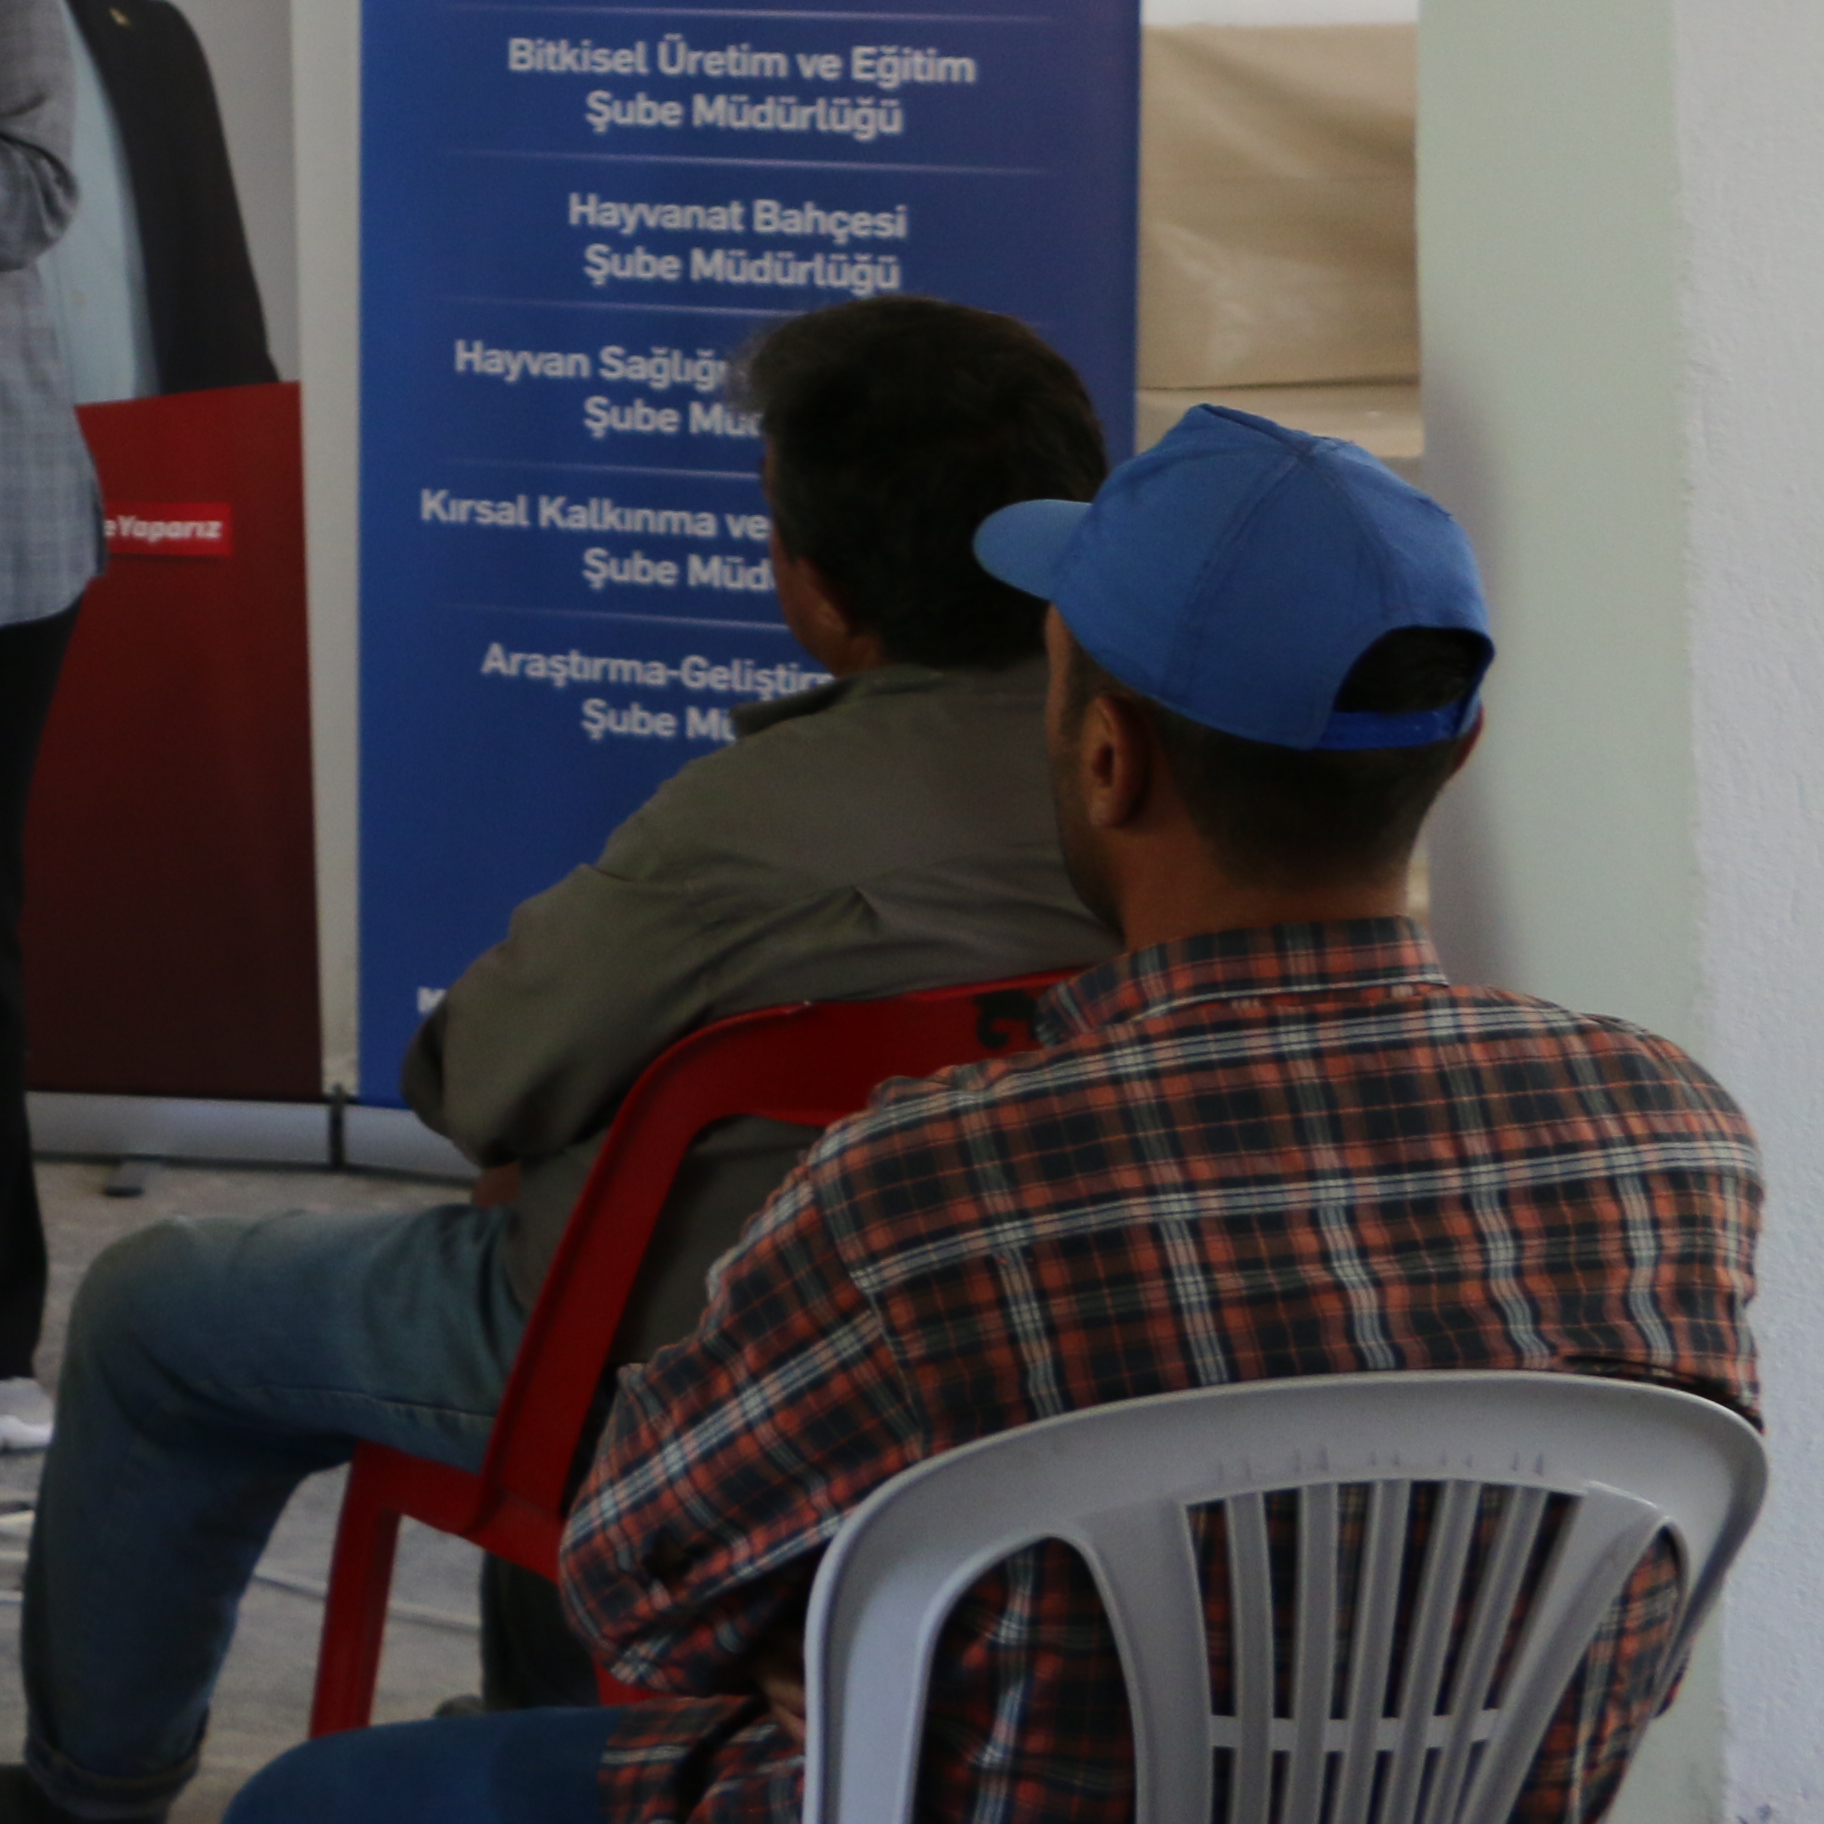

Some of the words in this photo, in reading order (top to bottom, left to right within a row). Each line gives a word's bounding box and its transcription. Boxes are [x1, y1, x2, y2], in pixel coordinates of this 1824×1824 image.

[508, 37, 650, 75] Bitkisel
[657, 33, 789, 78] Üretim
[796, 53, 843, 81] ve
[851, 45, 977, 90] Eğitim
[585, 89, 684, 134] Şube
[692, 93, 904, 142] Müdürlüğü
[568, 192, 745, 236] Hayvanat
[752, 198, 908, 246] Bahçesi
[584, 243, 682, 287] Şube
[690, 247, 901, 298] Müdürlüğü
[454, 339, 592, 383] Hayvan
[583, 395, 681, 439] Şube
[420, 488, 530, 528] Kırsal
[538, 495, 718, 539] Kalkınma
[725, 514, 772, 542] ve
[582, 546, 680, 590] Şube
[482, 642, 836, 702] Araştırma-Geliştir
[581, 697, 678, 741] Şube
